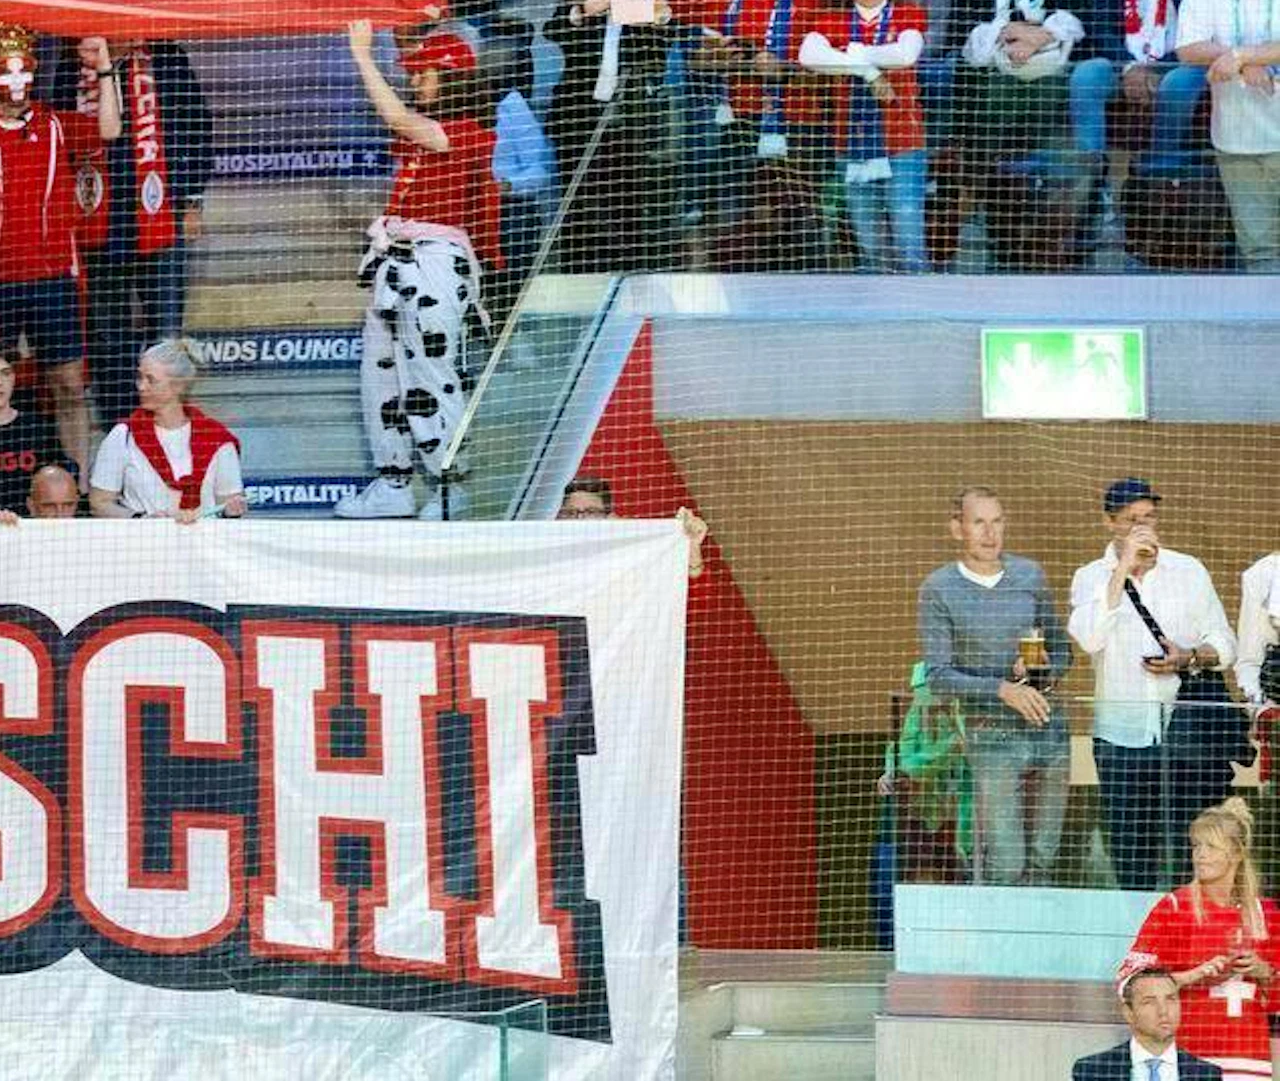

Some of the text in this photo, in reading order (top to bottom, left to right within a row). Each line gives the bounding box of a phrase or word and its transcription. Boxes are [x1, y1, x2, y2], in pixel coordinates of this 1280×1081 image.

[214, 150, 354, 172] HOSPITALITY
[260, 336, 364, 362] LOUNGE
[244, 484, 357, 504] SPITALITY
